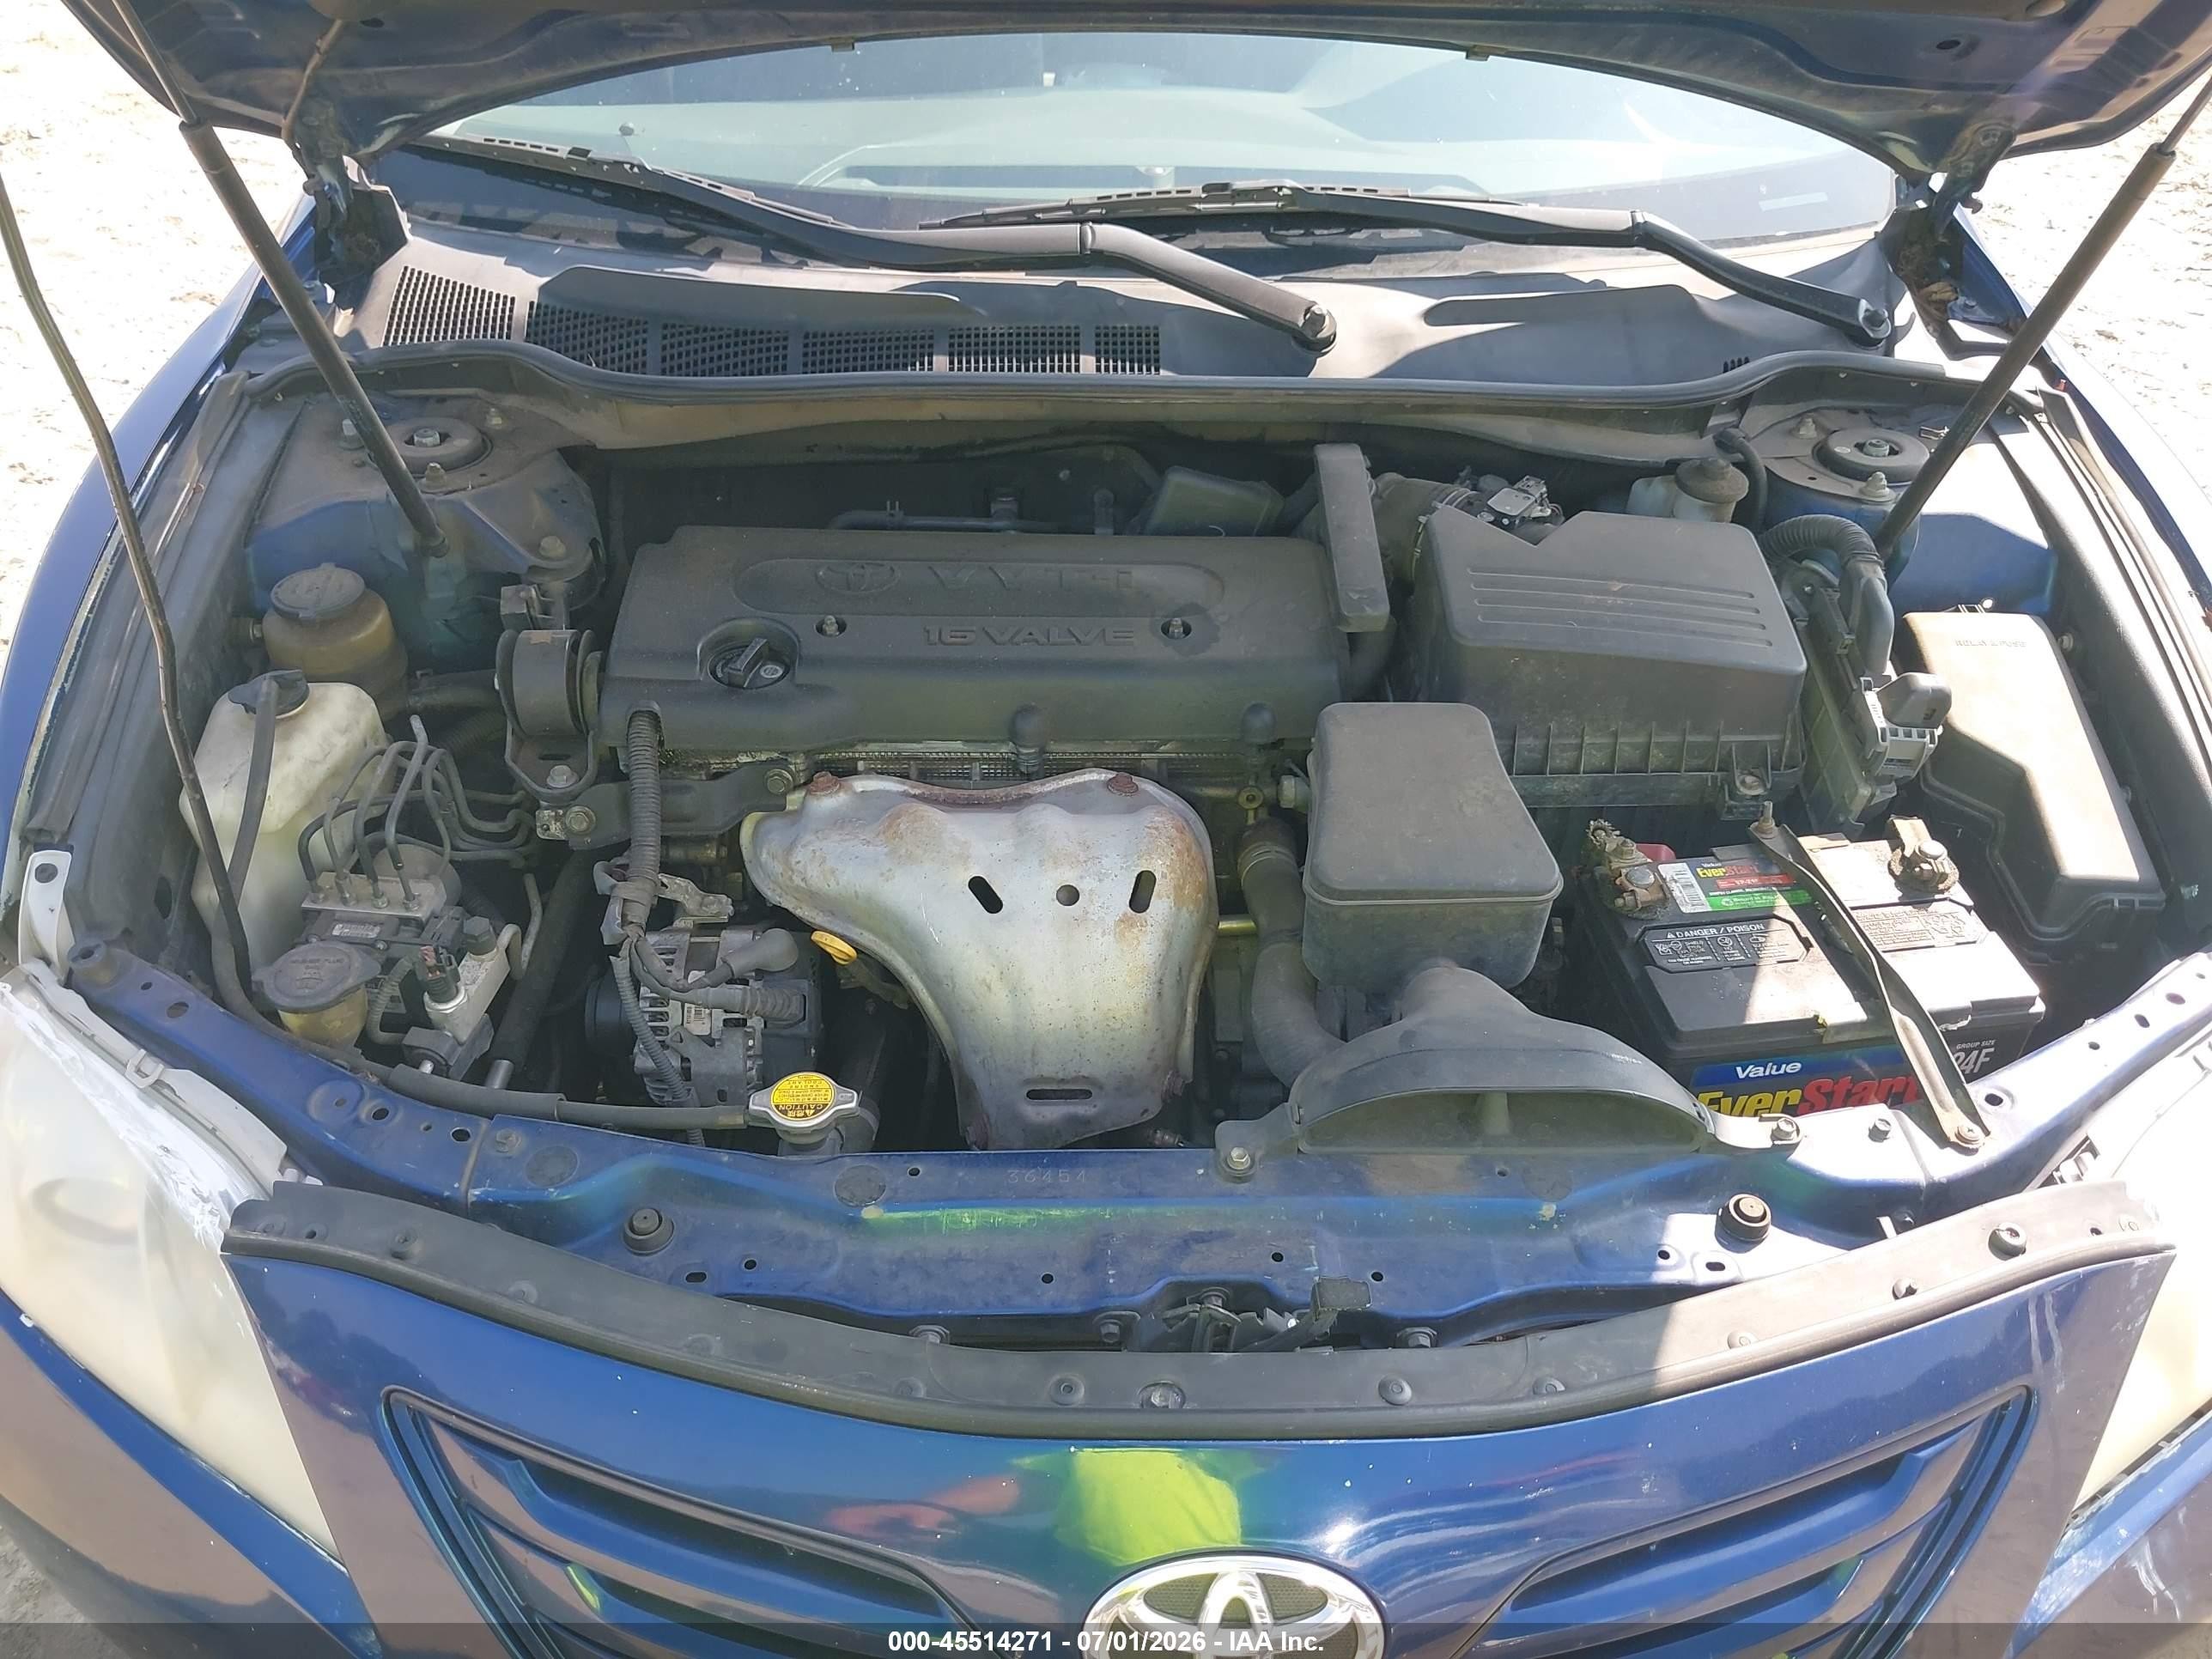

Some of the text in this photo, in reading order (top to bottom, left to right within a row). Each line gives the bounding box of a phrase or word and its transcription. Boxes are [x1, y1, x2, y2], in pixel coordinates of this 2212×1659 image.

[923, 626, 1135, 646] 16 VALVE
[1675, 927, 1718, 938] DANGER
[1726, 922, 1765, 933] POISON
[1735, 1061, 1802, 1079] Value
